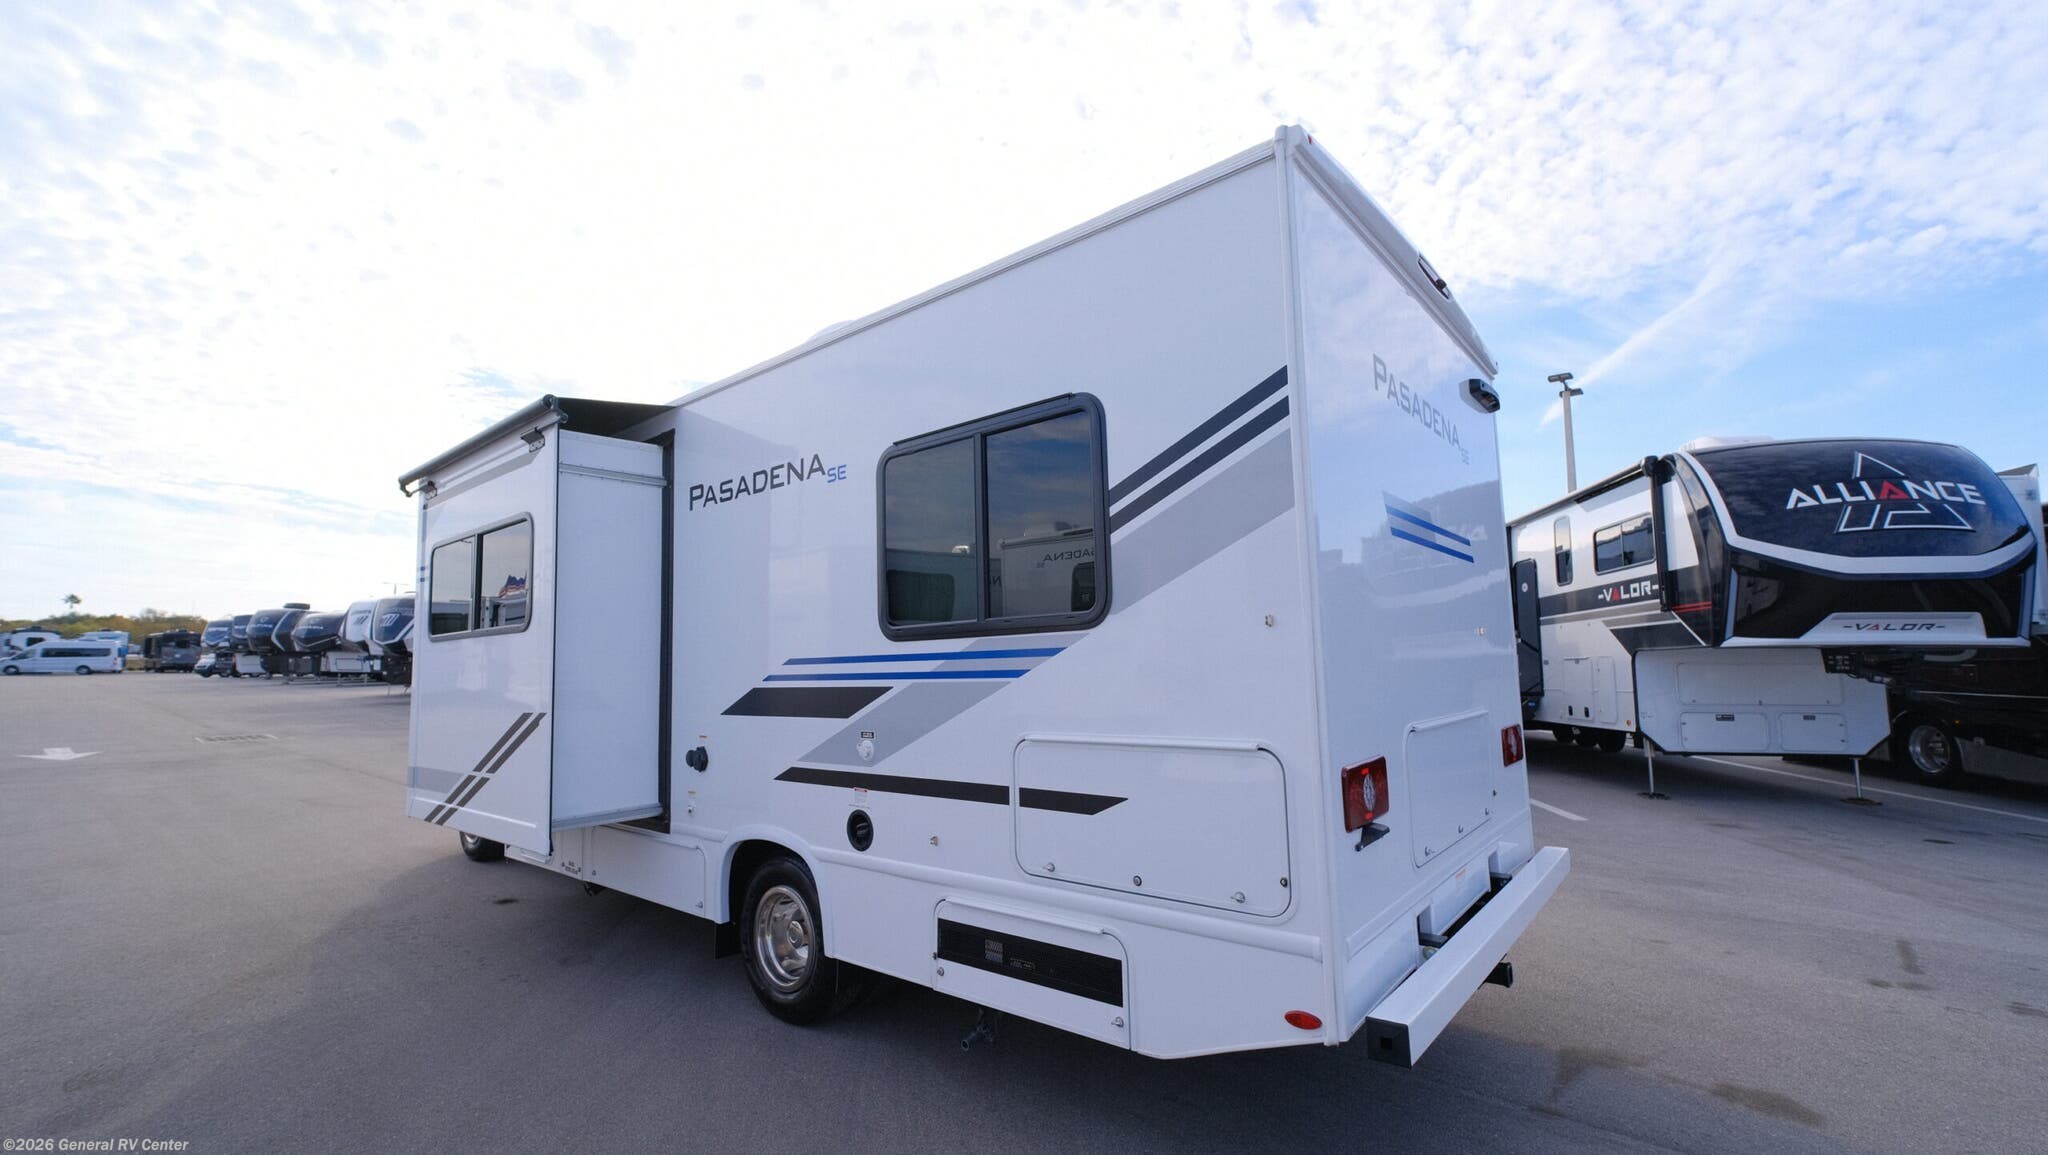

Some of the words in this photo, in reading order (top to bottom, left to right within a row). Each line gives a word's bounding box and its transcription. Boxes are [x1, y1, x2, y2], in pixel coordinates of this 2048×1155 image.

[1373, 353, 1461, 450] PASADENA
[689, 453, 826, 511] PASADENA
[827, 464, 848, 484] SE
[1786, 480, 1986, 510] ALLIANCE
